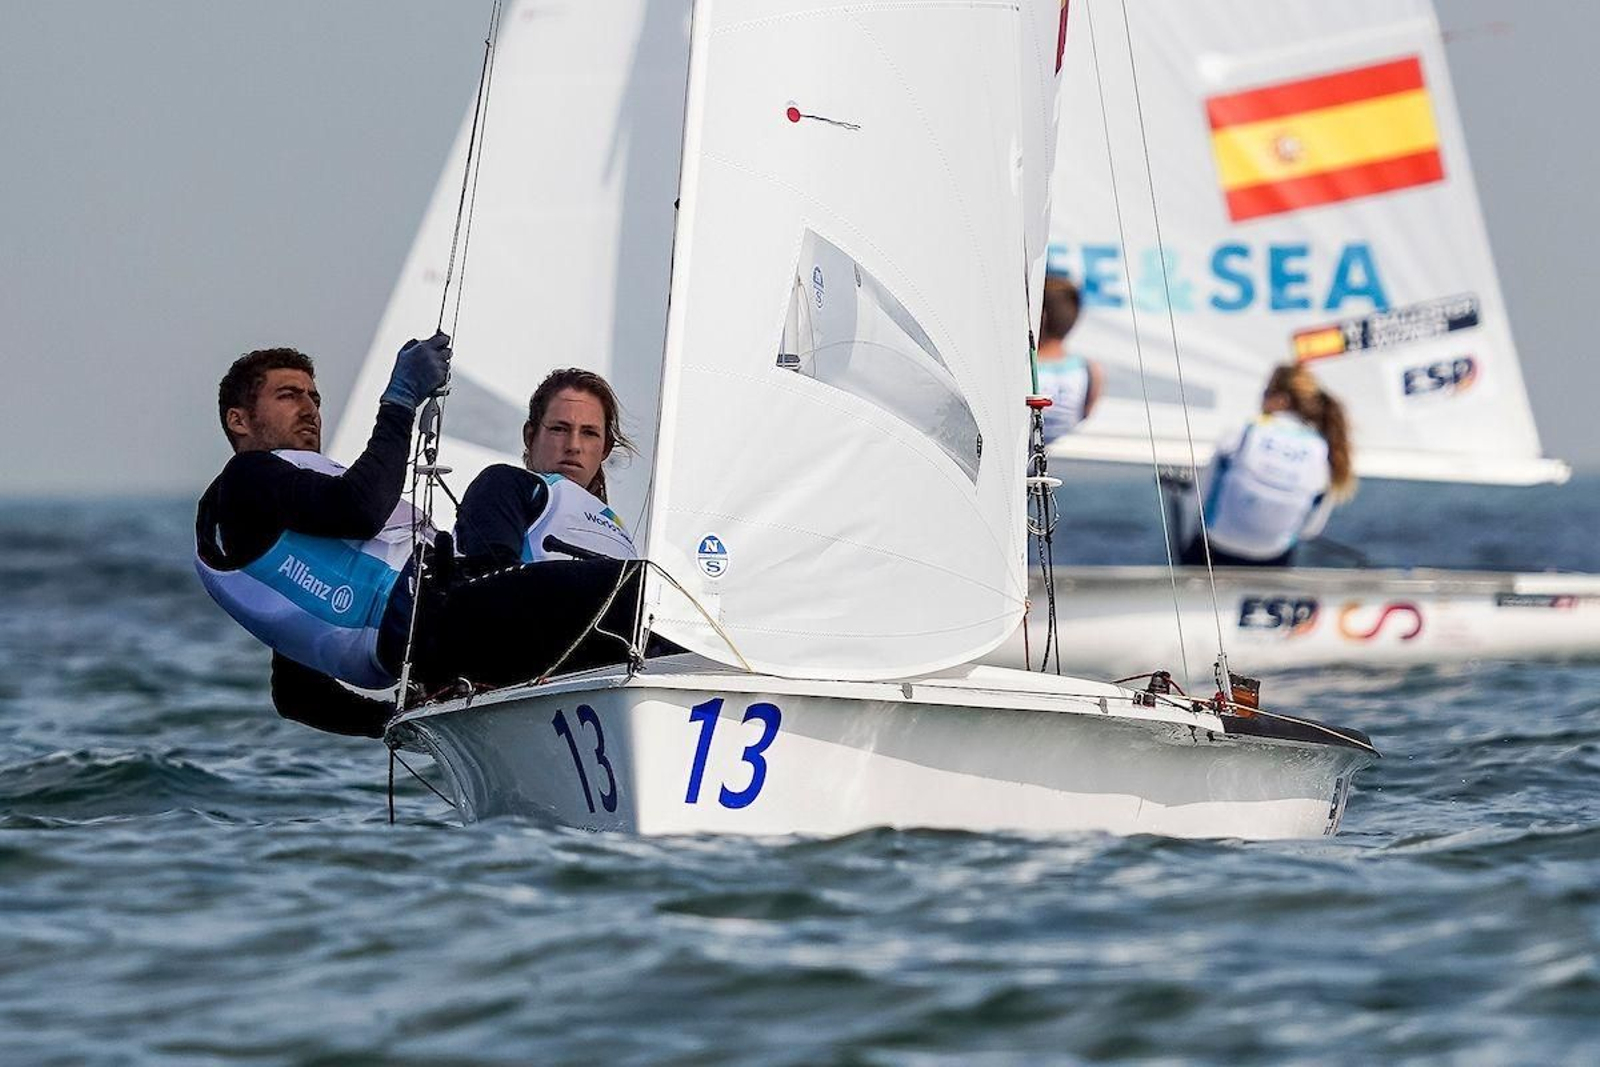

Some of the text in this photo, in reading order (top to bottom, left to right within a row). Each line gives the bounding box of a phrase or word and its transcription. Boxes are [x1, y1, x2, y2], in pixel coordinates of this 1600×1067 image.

[1135, 247, 1195, 312] &
[1209, 244, 1390, 312] SEA
[703, 539, 719, 552] N
[706, 560, 721, 573] S
[278, 554, 332, 601] Allianz
[551, 703, 617, 813] 13
[685, 698, 782, 810] 13
